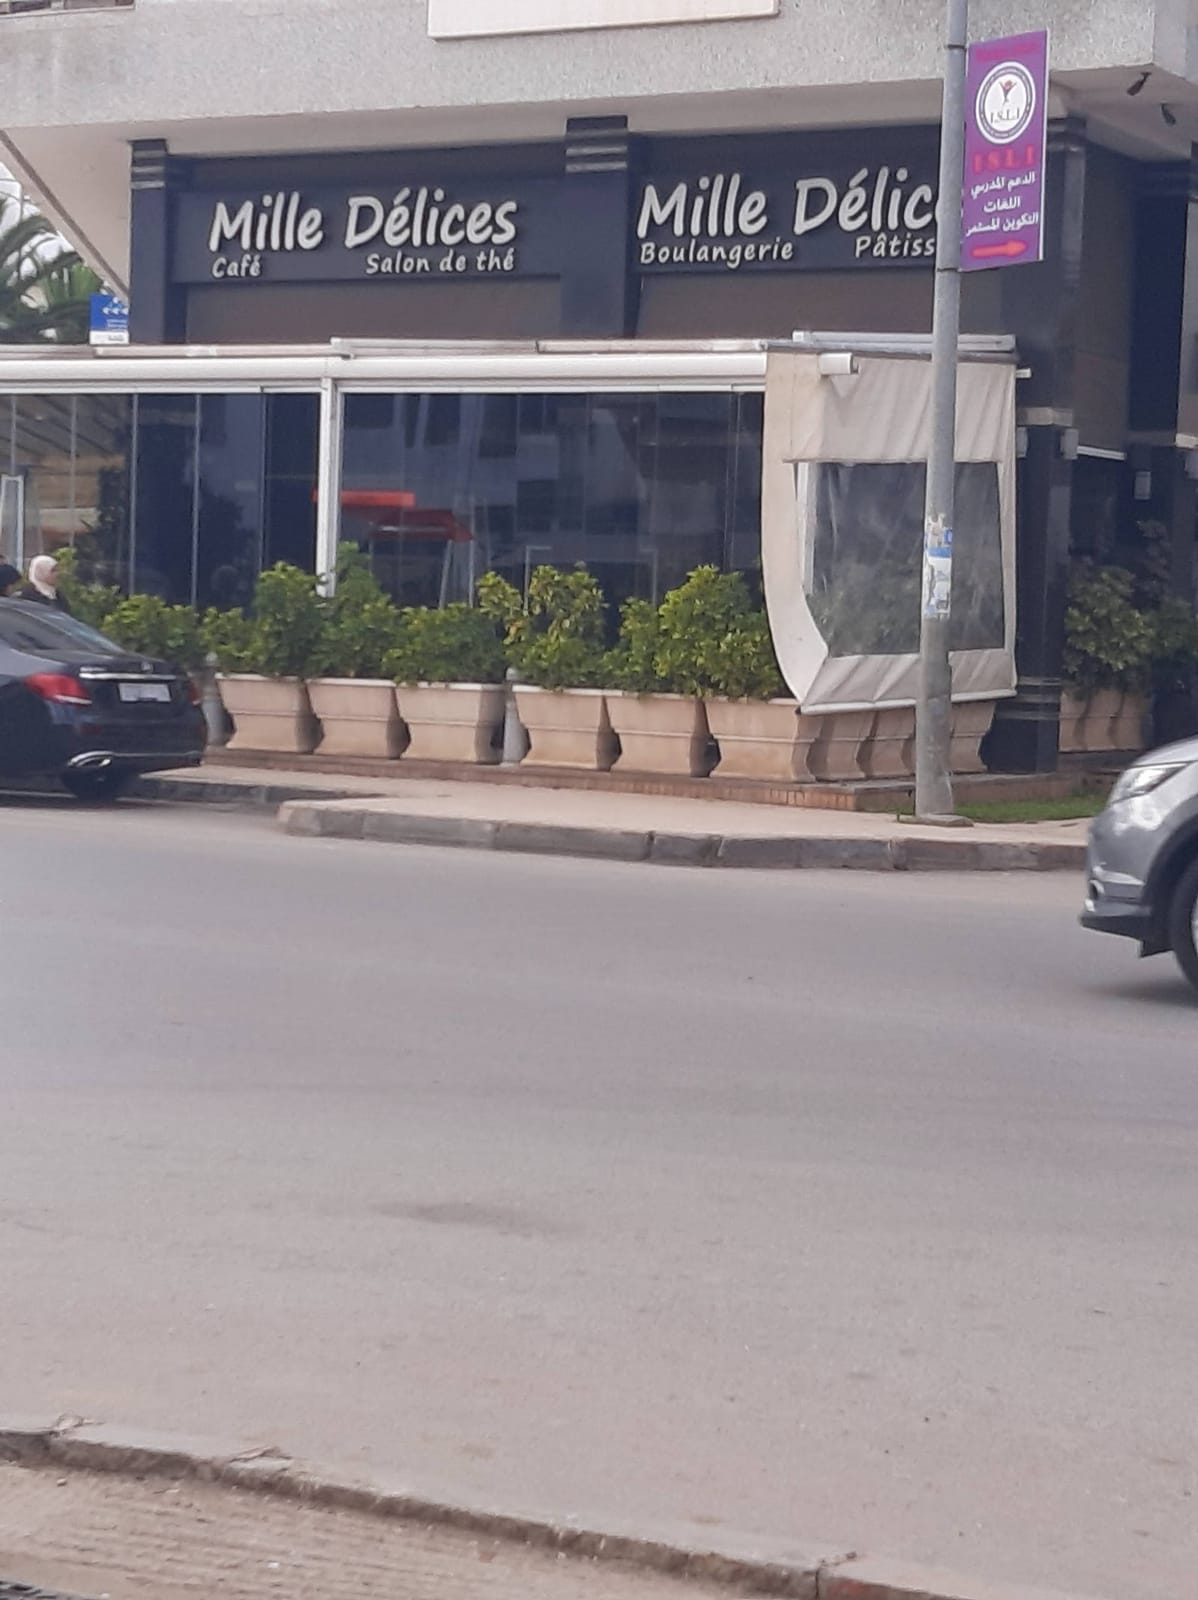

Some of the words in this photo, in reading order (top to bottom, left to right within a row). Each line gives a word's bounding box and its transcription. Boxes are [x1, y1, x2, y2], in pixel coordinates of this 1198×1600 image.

[1007, 171, 1036, 193] الدعم
[636, 173, 768, 239] Mille
[793, 167, 933, 236] Délic
[983, 196, 1021, 213] اللغات
[209, 191, 324, 252] Mille
[344, 187, 518, 249] Délices
[1002, 211, 1039, 231] التكوين
[365, 252, 430, 274] Salon
[439, 248, 466, 272] de
[476, 247, 515, 271] thé
[640, 237, 794, 269] Boulangerie
[855, 233, 936, 258] Pâtiss
[211, 254, 262, 279] Café
